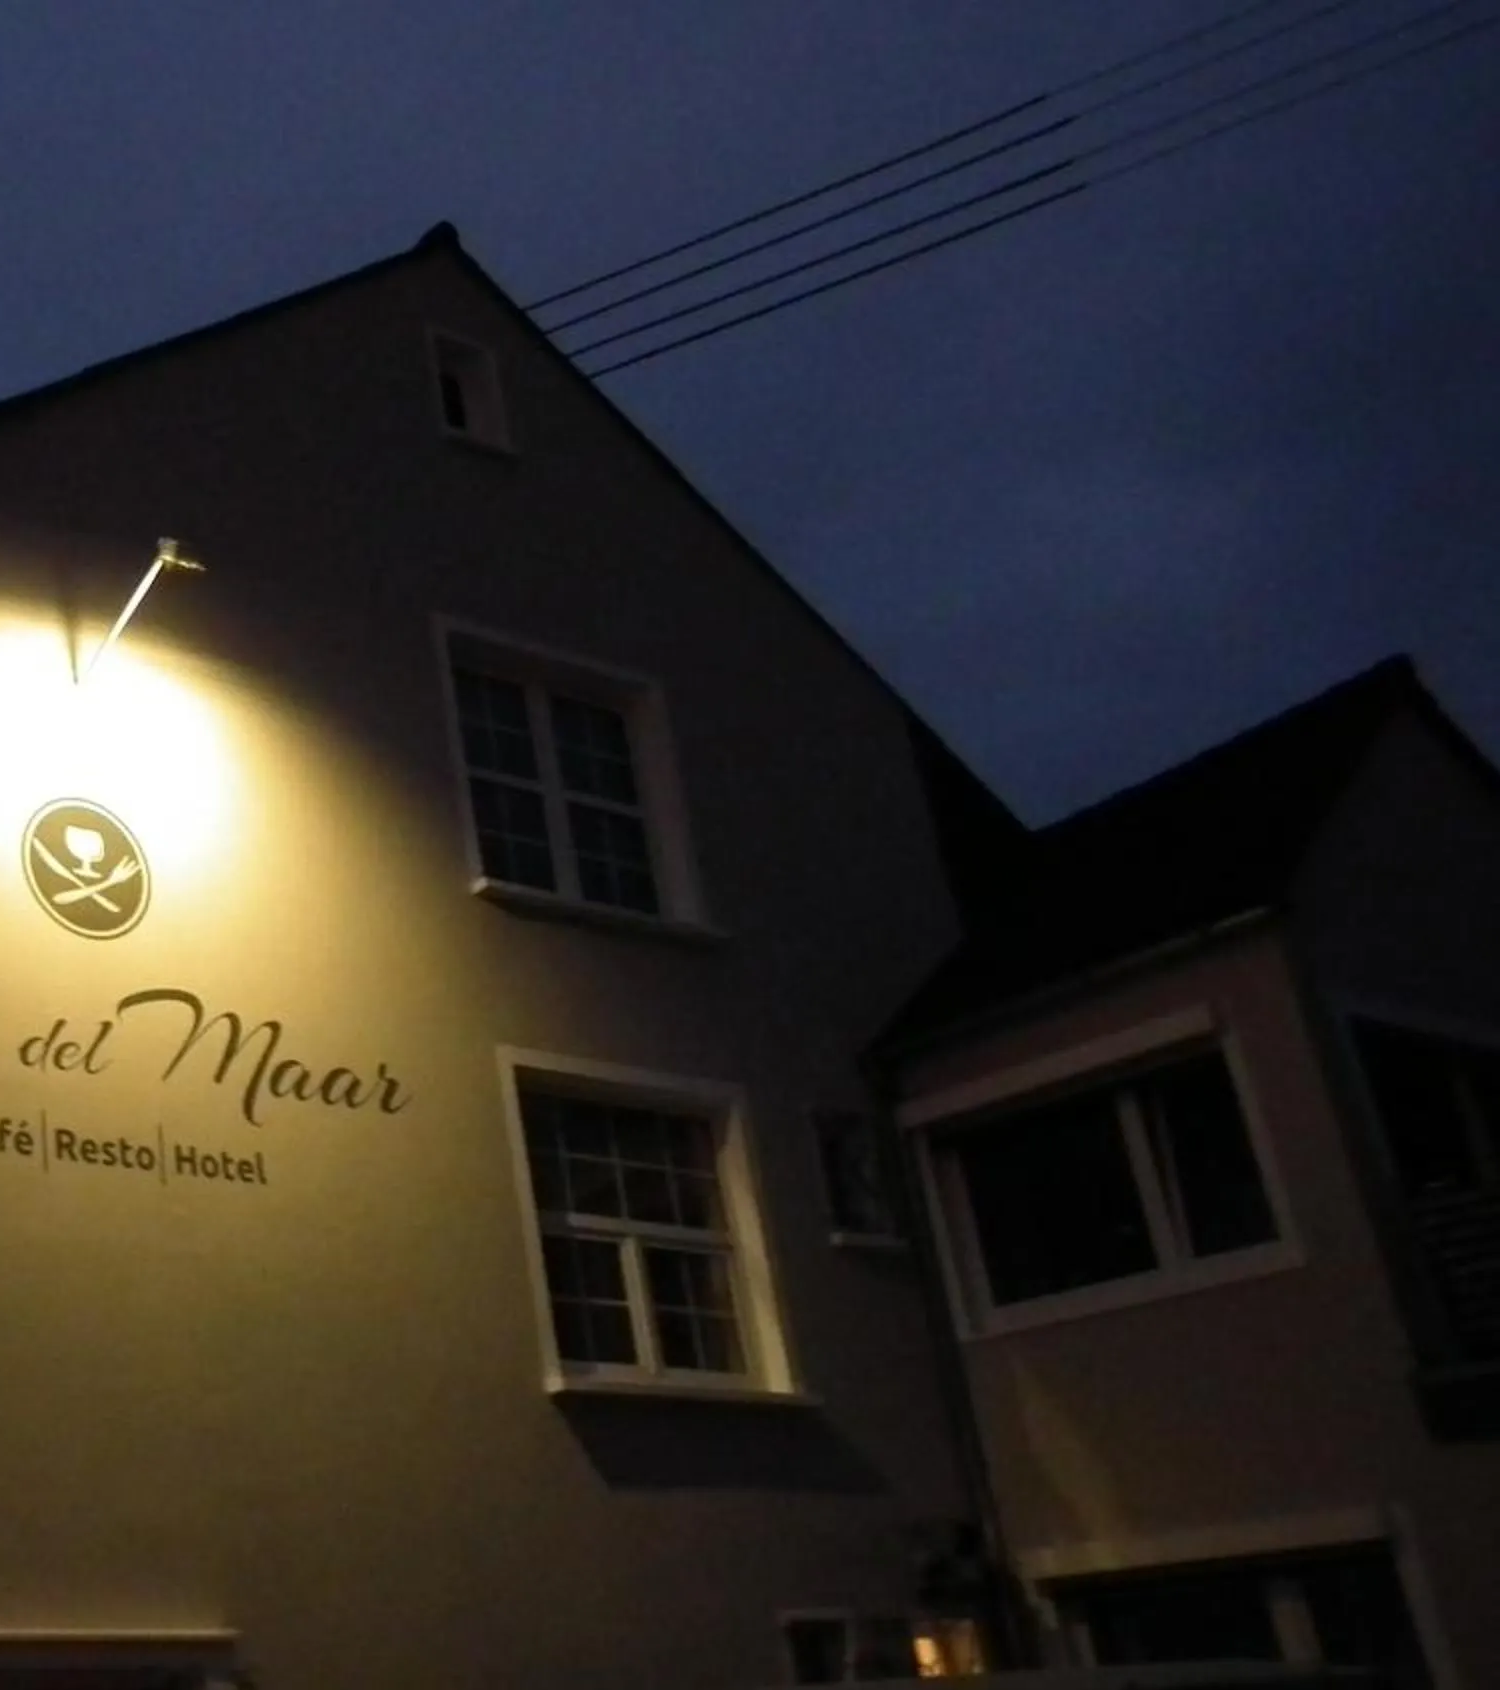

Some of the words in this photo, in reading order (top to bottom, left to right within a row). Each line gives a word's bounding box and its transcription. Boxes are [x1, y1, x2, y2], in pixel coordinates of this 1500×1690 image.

[18, 1018, 115, 1075] del
[116, 987, 412, 1127] Maar
[55, 1127, 156, 1172] Resto
[174, 1143, 268, 1186] Hotel
